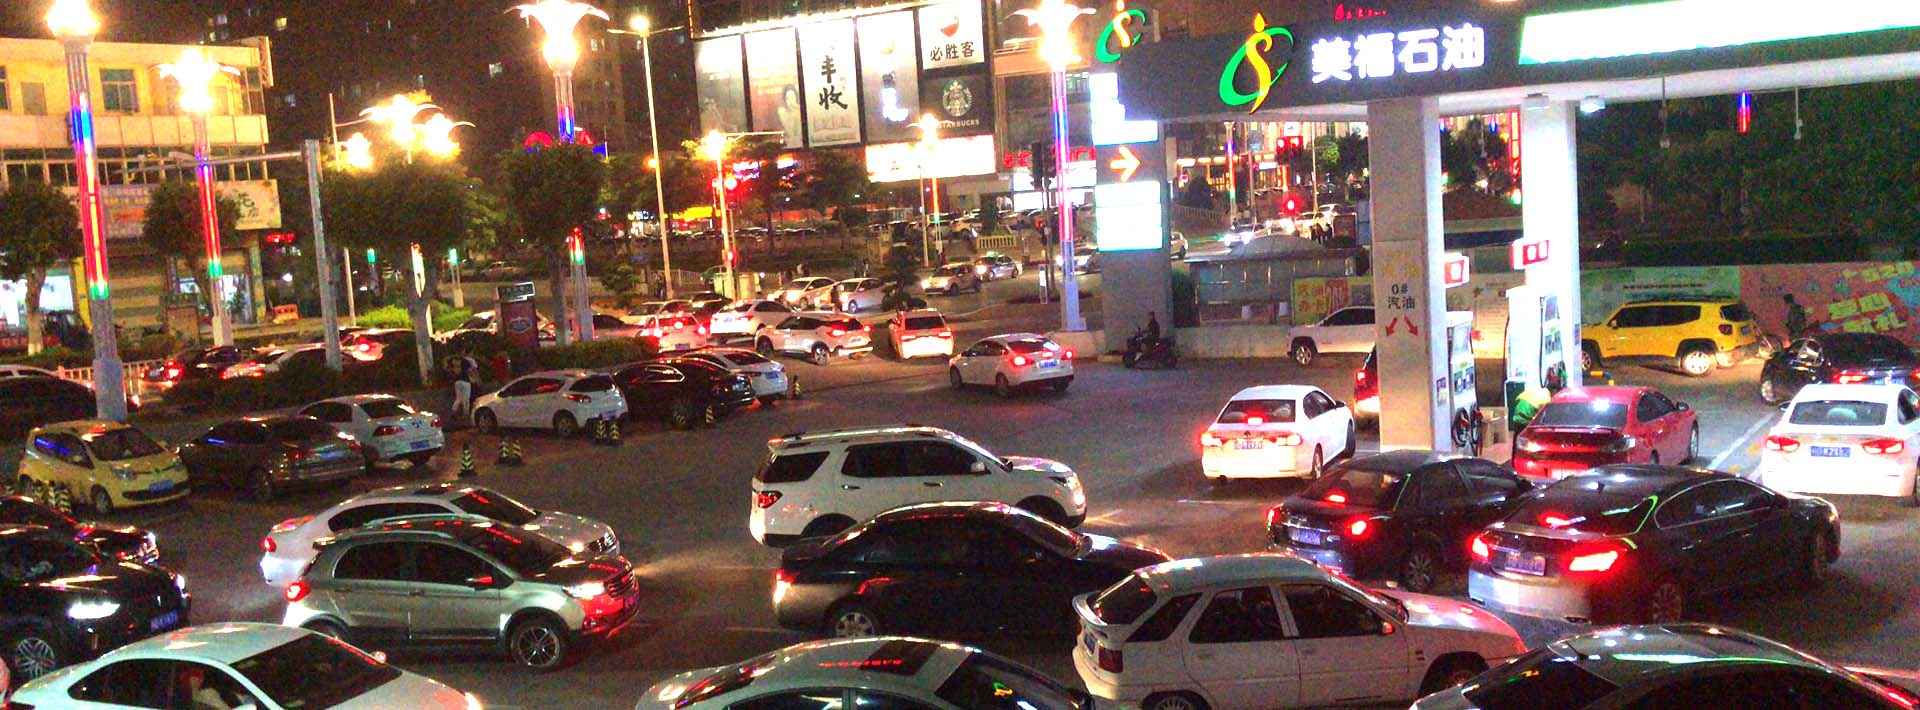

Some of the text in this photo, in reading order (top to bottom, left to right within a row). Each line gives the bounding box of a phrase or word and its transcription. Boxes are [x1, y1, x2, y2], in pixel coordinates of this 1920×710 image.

[929, 41, 975, 62] 必胜客
[1311, 22, 1485, 84] 美福石油
[1387, 297, 1416, 310] 汽油
